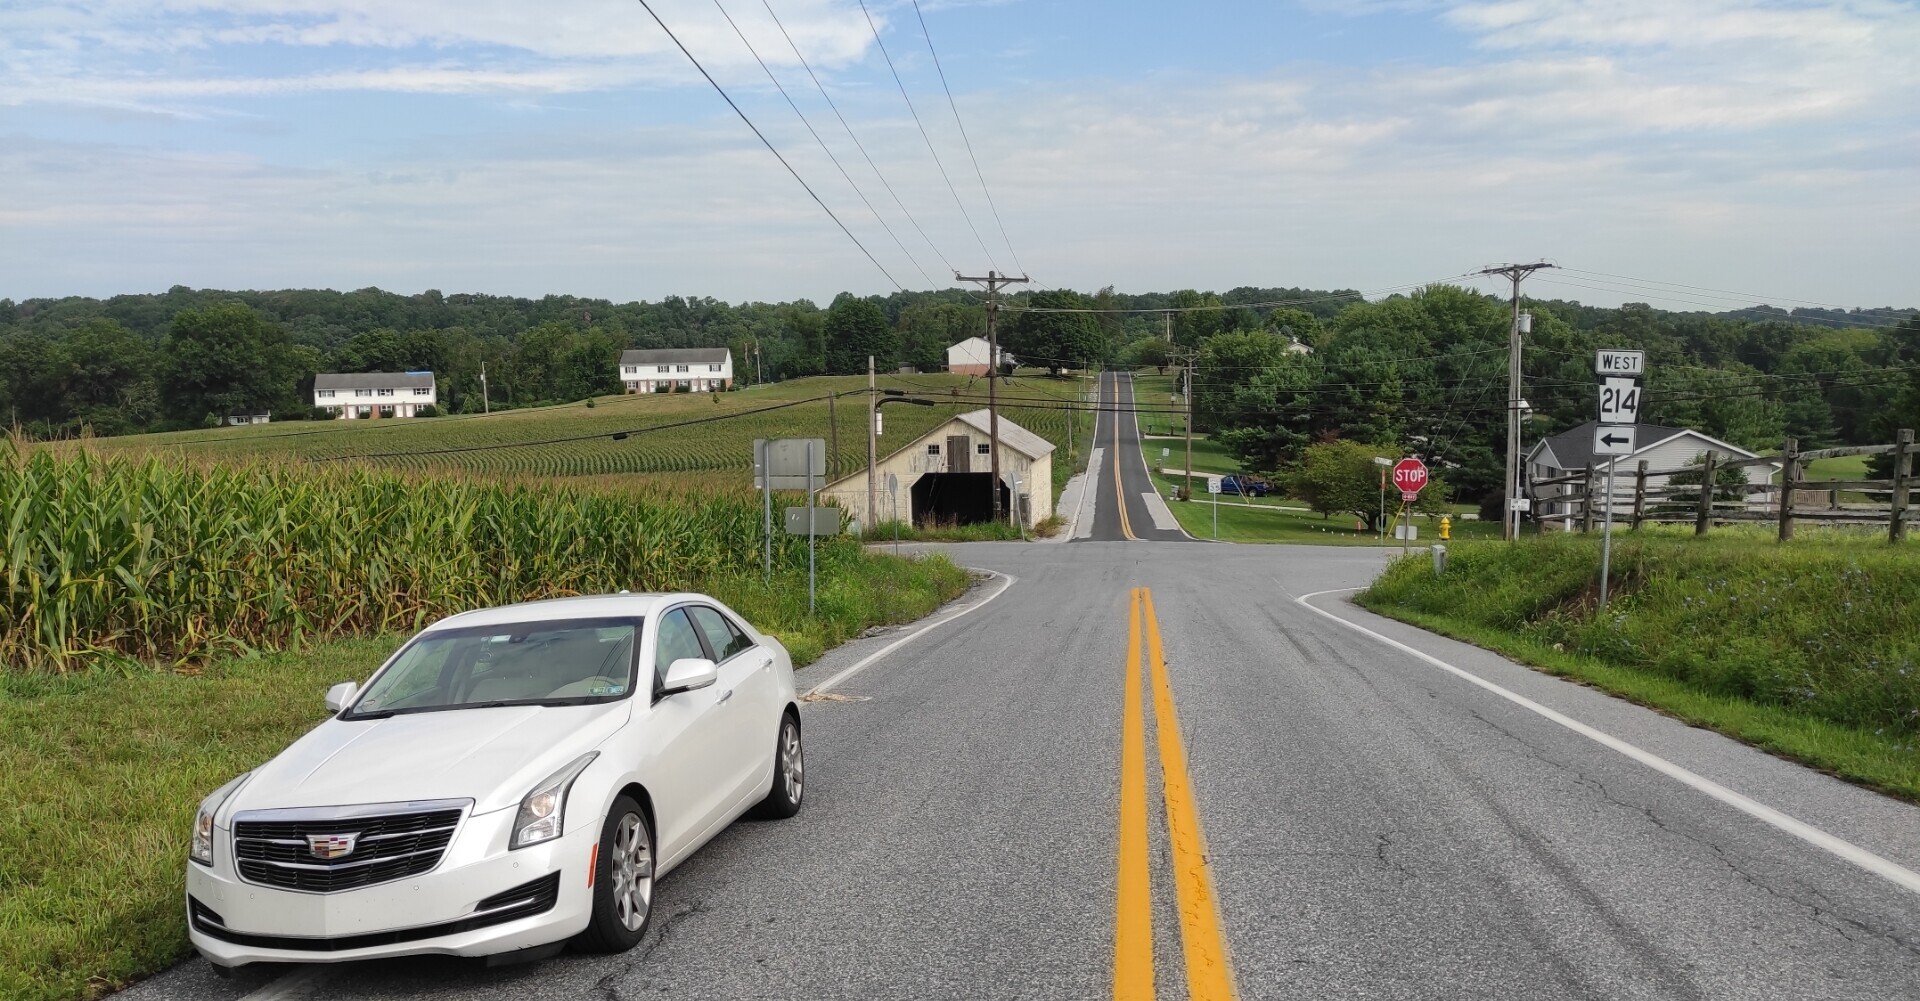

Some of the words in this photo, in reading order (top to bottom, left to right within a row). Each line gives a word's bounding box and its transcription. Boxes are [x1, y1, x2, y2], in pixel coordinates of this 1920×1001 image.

[1602, 354, 1638, 370] WEST
[1601, 388, 1636, 414] 214
[1395, 469, 1426, 483] STOP
